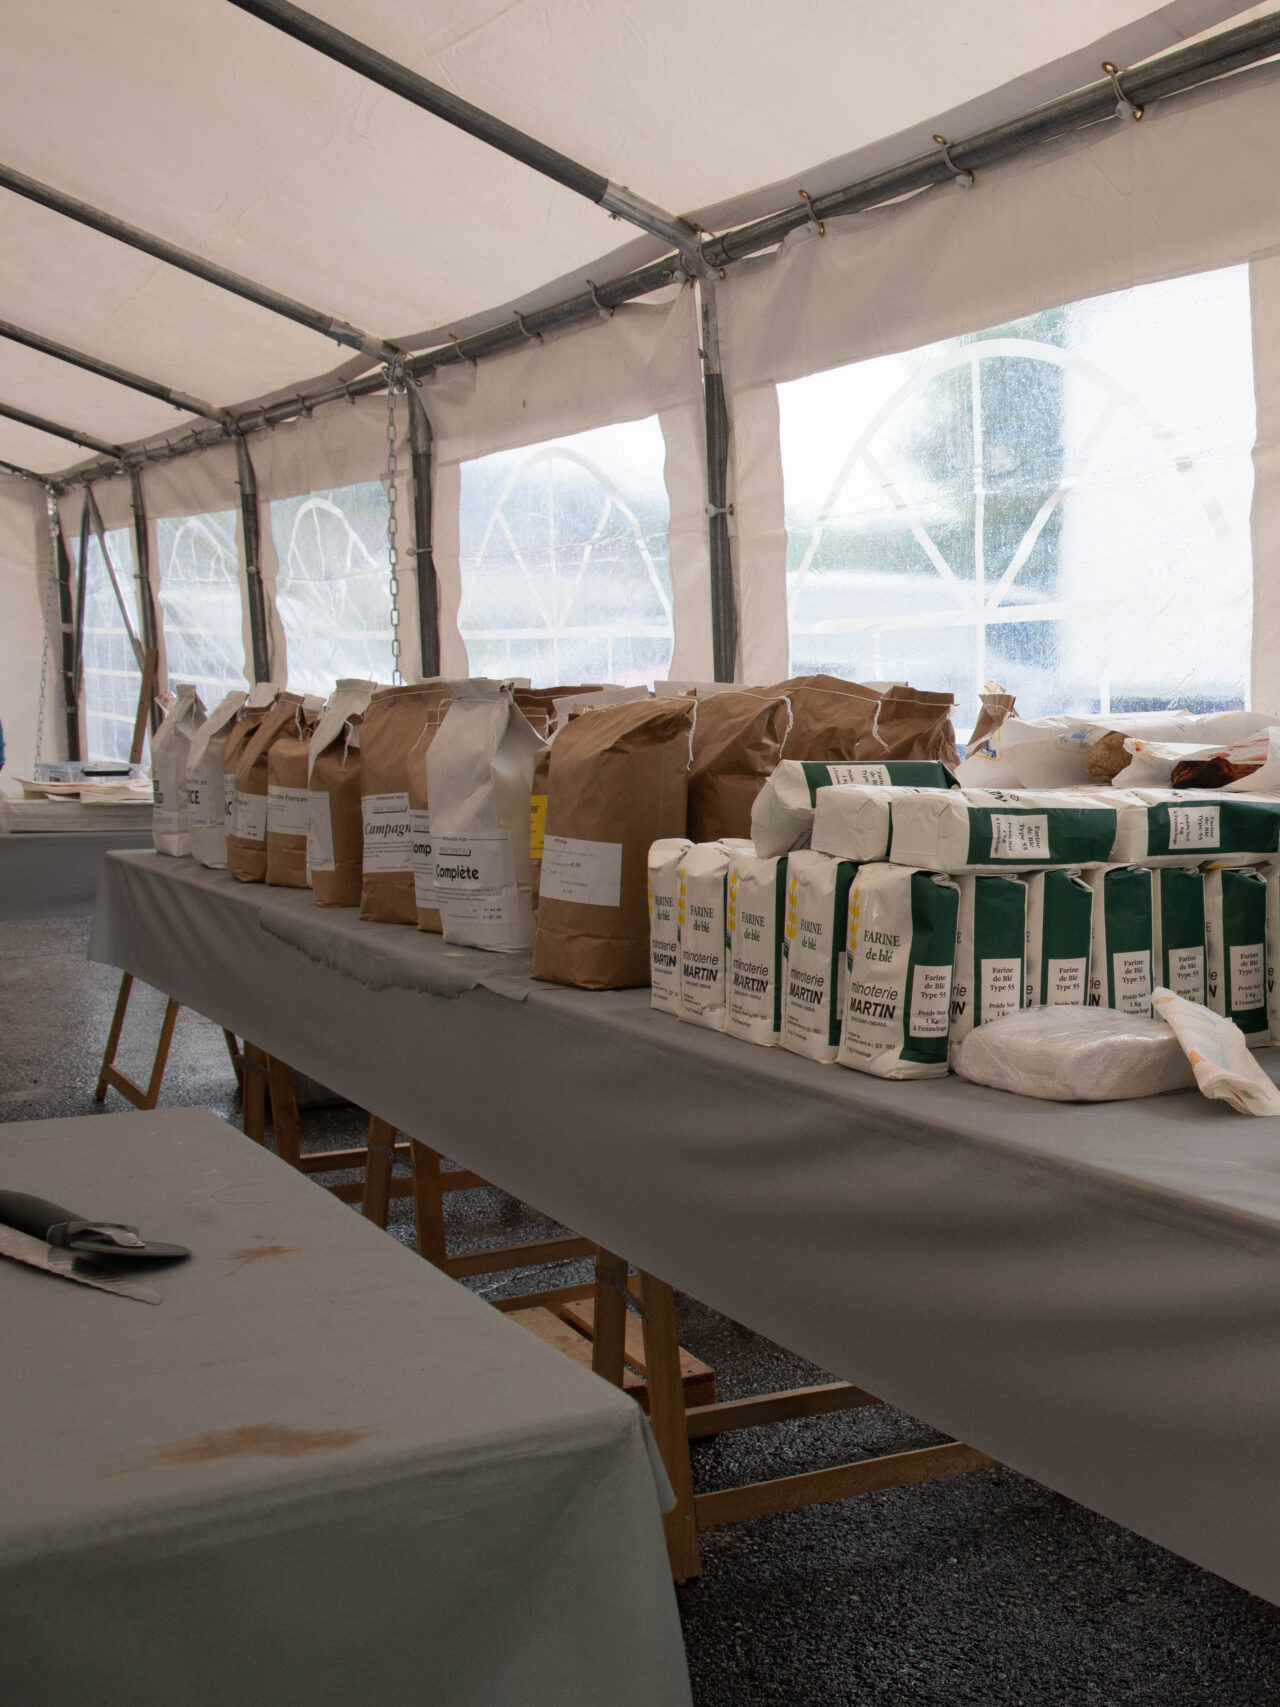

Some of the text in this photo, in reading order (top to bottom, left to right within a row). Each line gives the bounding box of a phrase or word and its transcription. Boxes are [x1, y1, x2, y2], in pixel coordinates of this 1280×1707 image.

[436, 864, 479, 881] Complète
[741, 911, 765, 927] FARINE
[800, 918, 822, 935] FARINE
[801, 936, 817, 951] de blé
[864, 929, 901, 947] FARINE
[683, 950, 719, 966] minoterie
[865, 948, 893, 963] de blé
[683, 963, 718, 982] MARTIN
[733, 958, 769, 976] minoterie
[733, 972, 769, 993] MARTIN
[790, 967, 824, 987] minoterie
[924, 974, 947, 982] Farine
[1002, 974, 1013, 982] Blé
[1068, 974, 1078, 982] Blé
[1122, 976, 1138, 985] Type
[1177, 972, 1192, 980] Type
[789, 982, 823, 1005] MARTIN
[851, 981, 898, 1001] minoterie
[924, 982, 946, 990] de Blé
[990, 984, 1006, 993] Type
[1056, 984, 1072, 992] Type
[920, 991, 947, 1000] Type 55
[851, 997, 896, 1019] MARTIN
[918, 1009, 936, 1017] Poids
